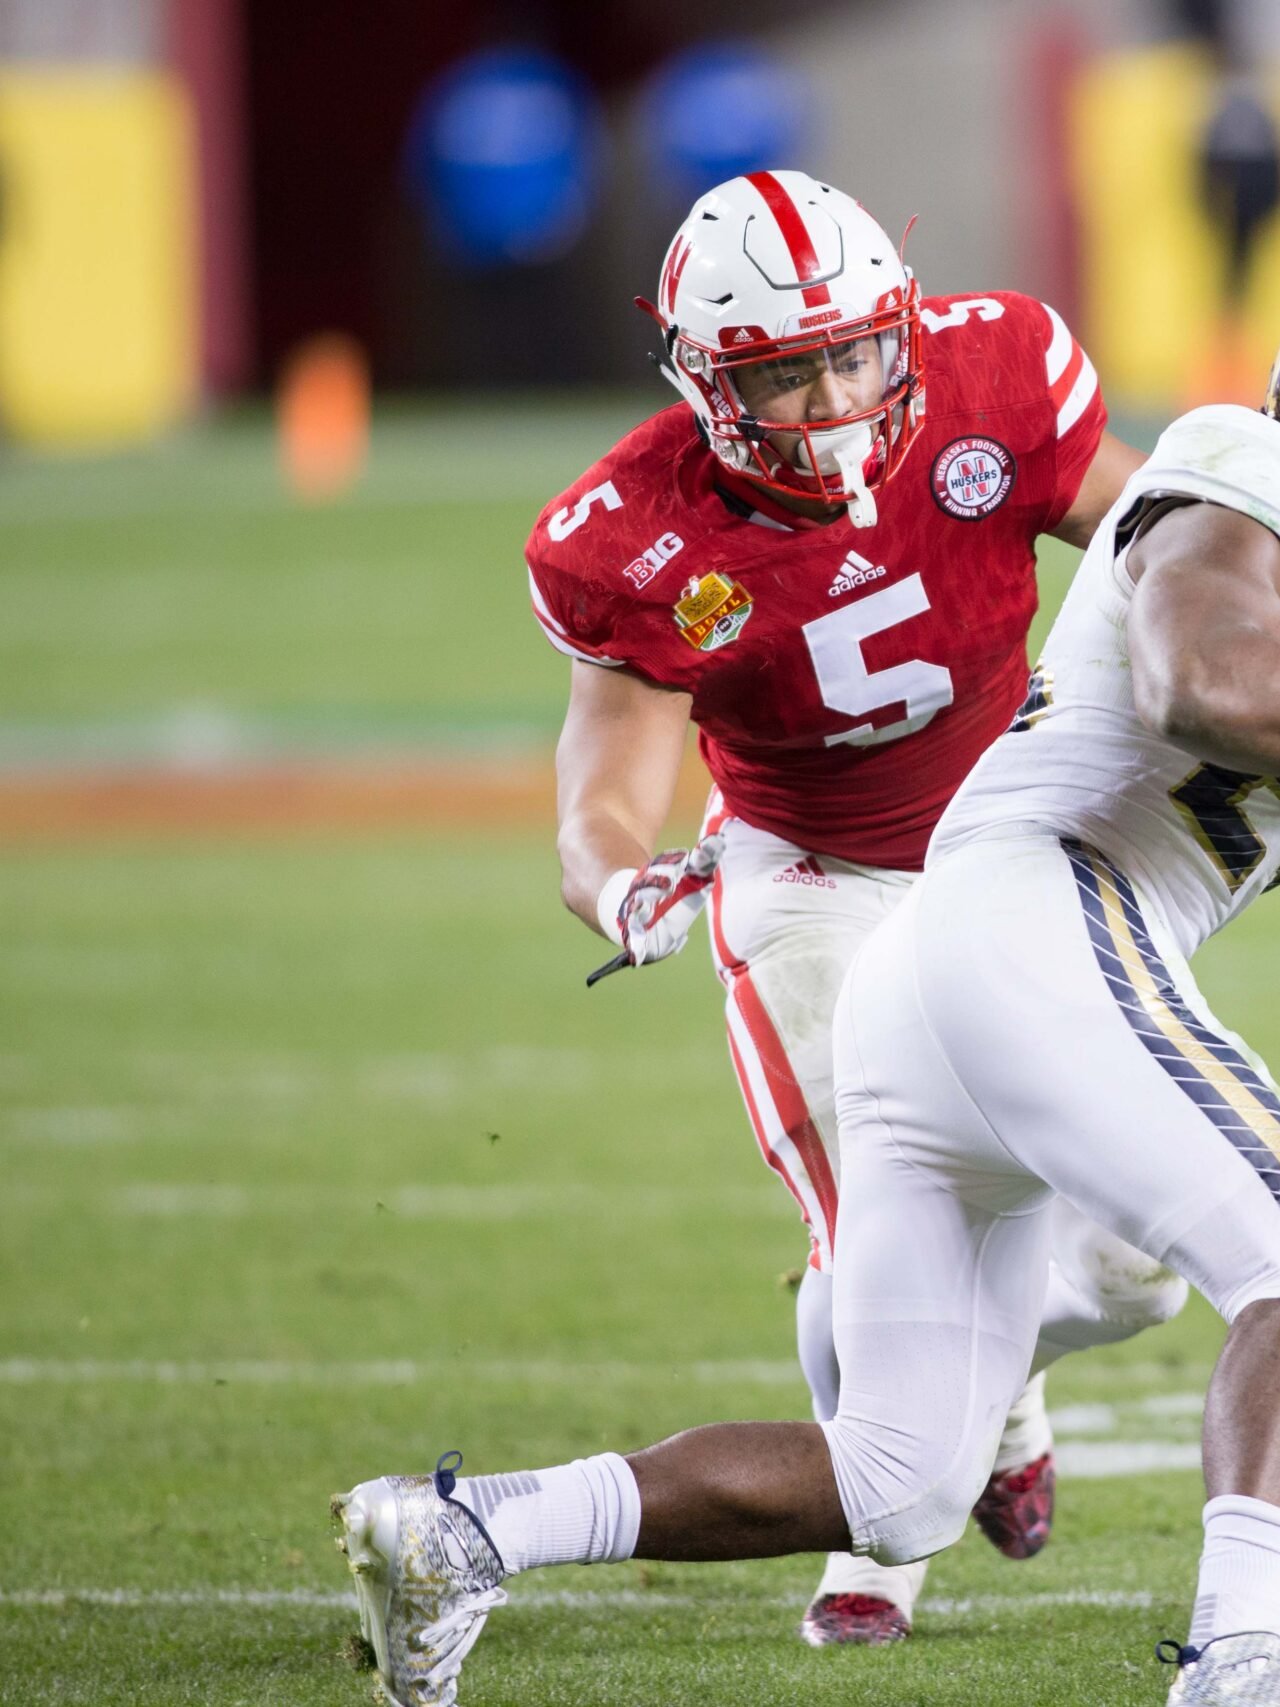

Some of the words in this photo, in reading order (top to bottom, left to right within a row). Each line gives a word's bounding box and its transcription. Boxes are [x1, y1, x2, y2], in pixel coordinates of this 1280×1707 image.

[798, 308, 843, 330] HUSKERS
[919, 298, 1005, 335] 5
[937, 442, 968, 481] NEBRASKA
[972, 440, 1009, 467] FOOTBALL
[951, 469, 997, 489] HUSKERS
[547, 480, 624, 542] 5
[939, 490, 947, 499] A
[944, 498, 977, 517] WINNING
[980, 475, 1011, 512] TRADITION
[828, 565, 887, 597] adidas
[694, 598, 741, 637] BOWL
[801, 571, 954, 748] 5
[773, 872, 837, 889] adidas
